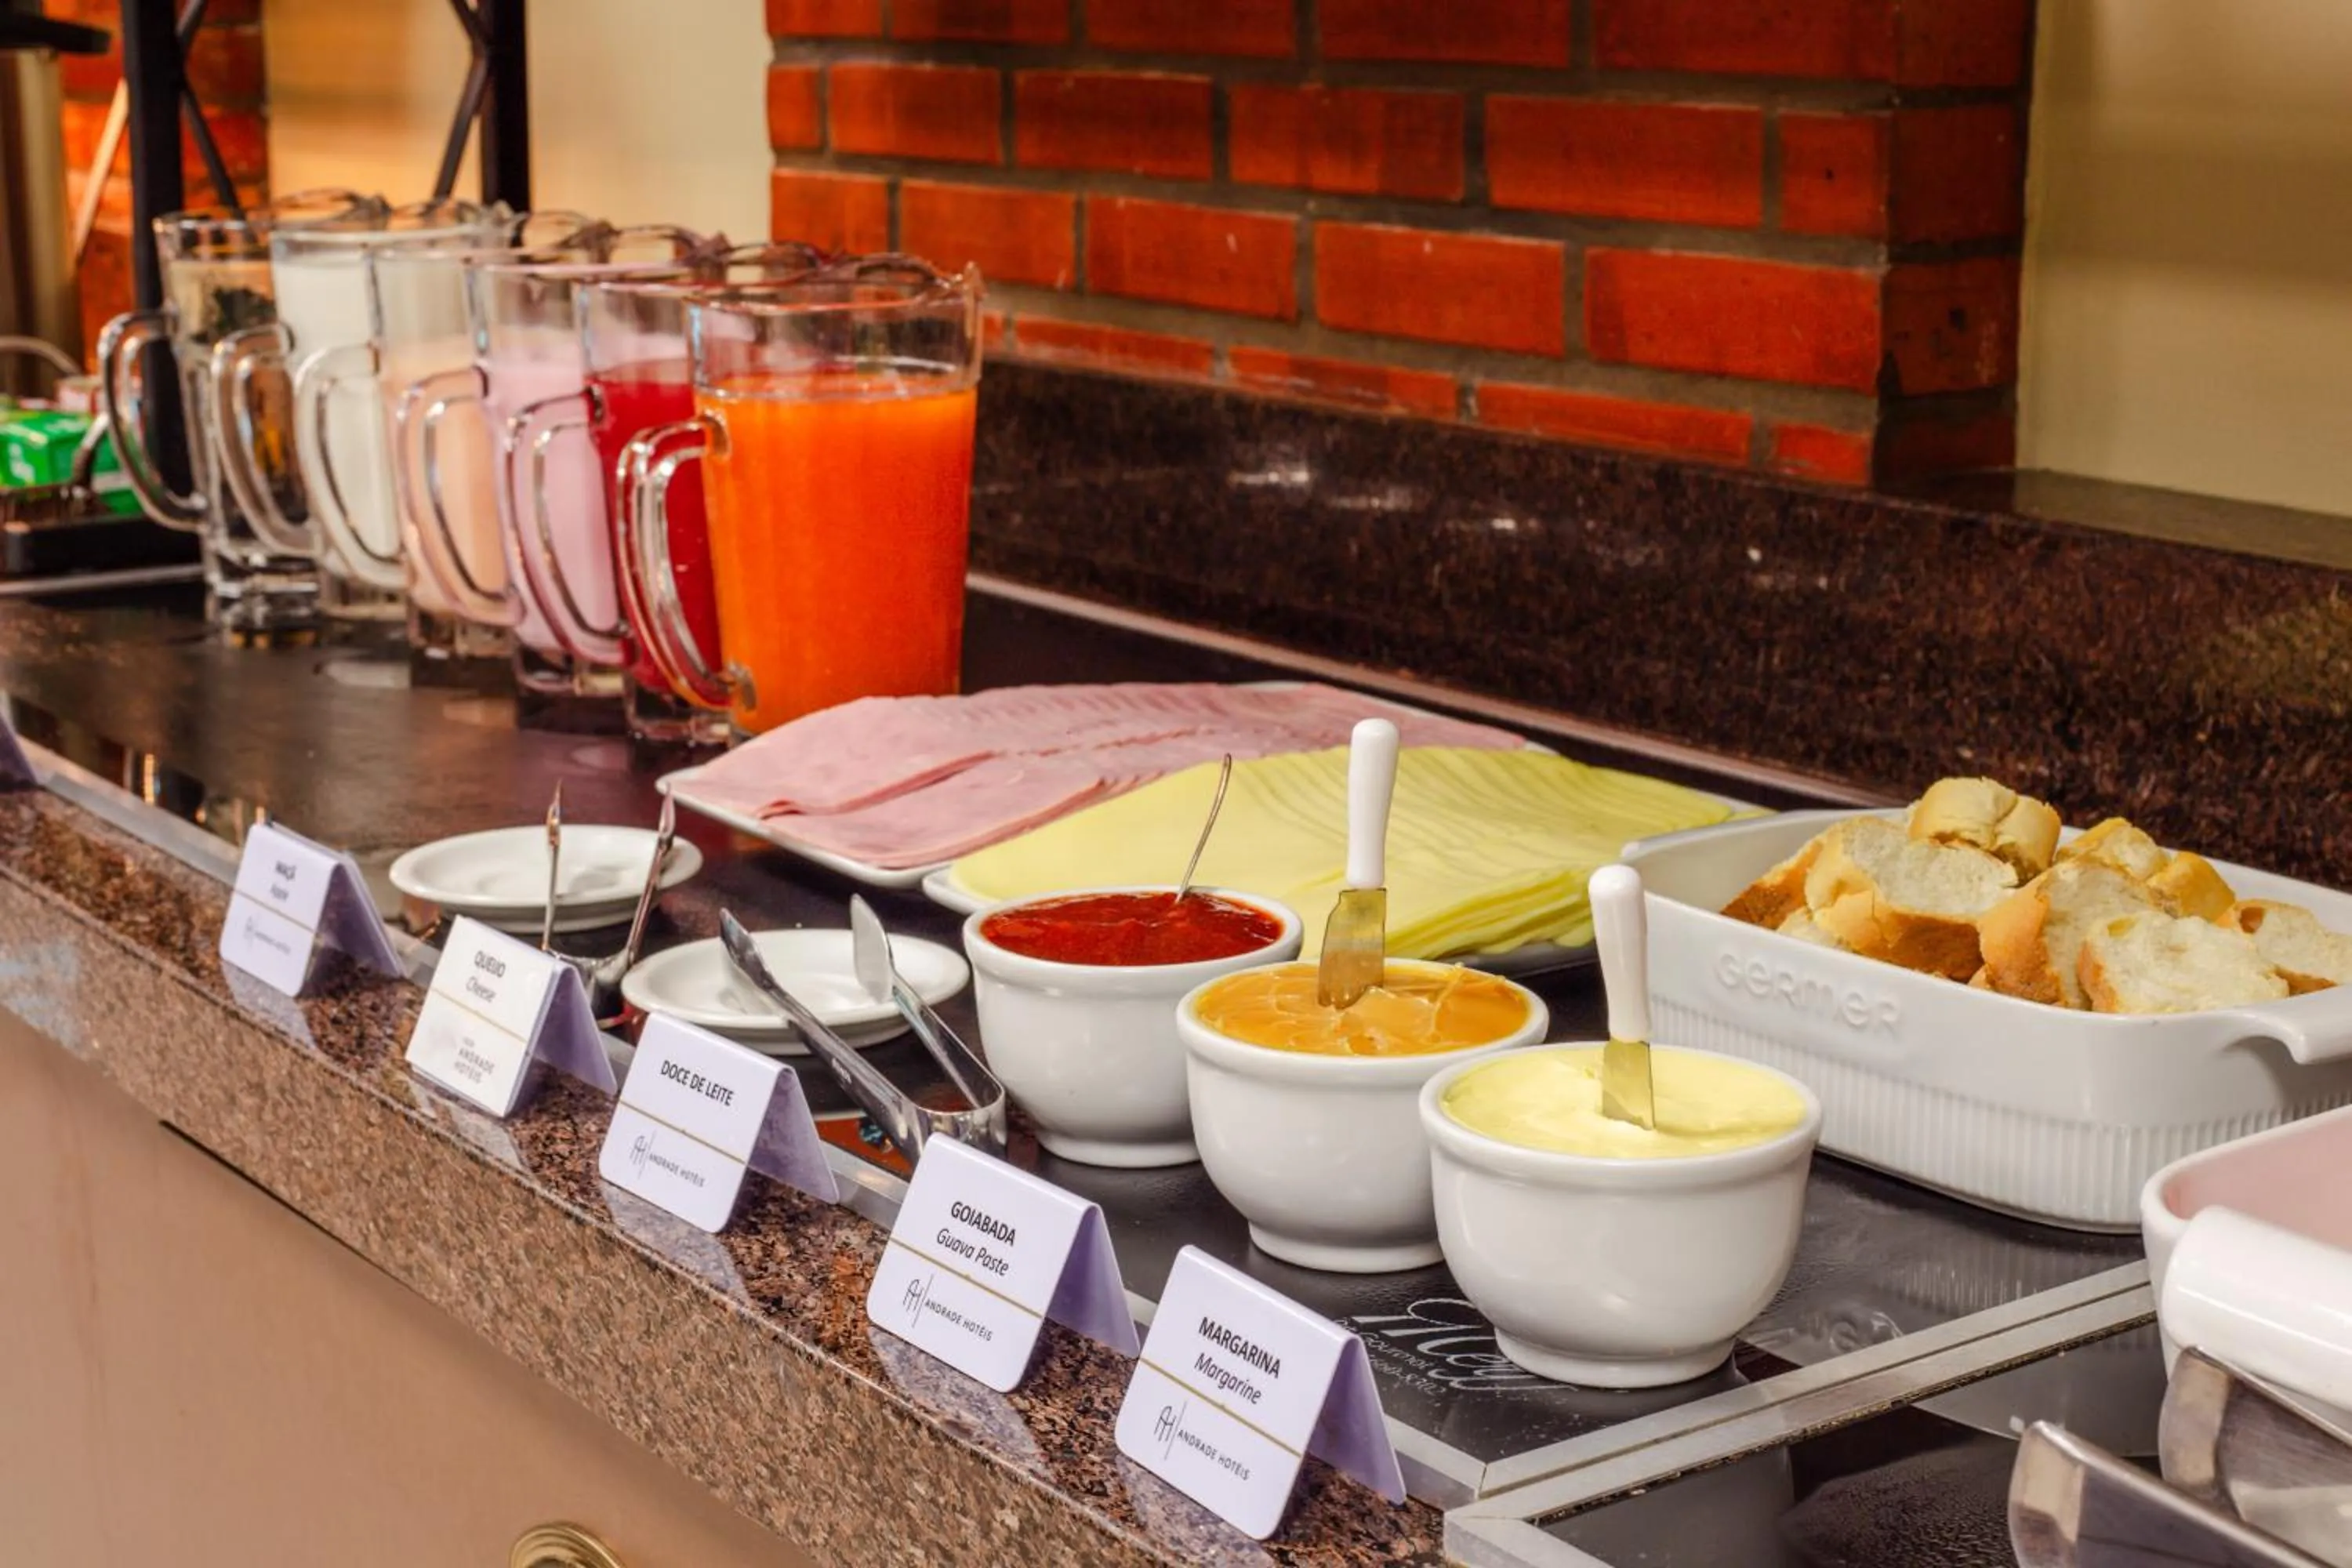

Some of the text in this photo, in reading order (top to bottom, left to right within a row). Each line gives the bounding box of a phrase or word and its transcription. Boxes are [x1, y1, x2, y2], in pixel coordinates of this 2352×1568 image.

[466, 976, 496, 1003] Cheese
[661, 1060, 735, 1107] DOCE DE LEITE
[951, 1201, 1017, 1247] GOIABADA
[937, 1229, 1010, 1276] Guava Paste
[924, 1298, 962, 1325] ANDRADE
[1199, 1316, 1281, 1379] MARGARINA
[1194, 1352, 1262, 1406] Margarine
[1177, 1429, 1218, 1460] ANDRADE
